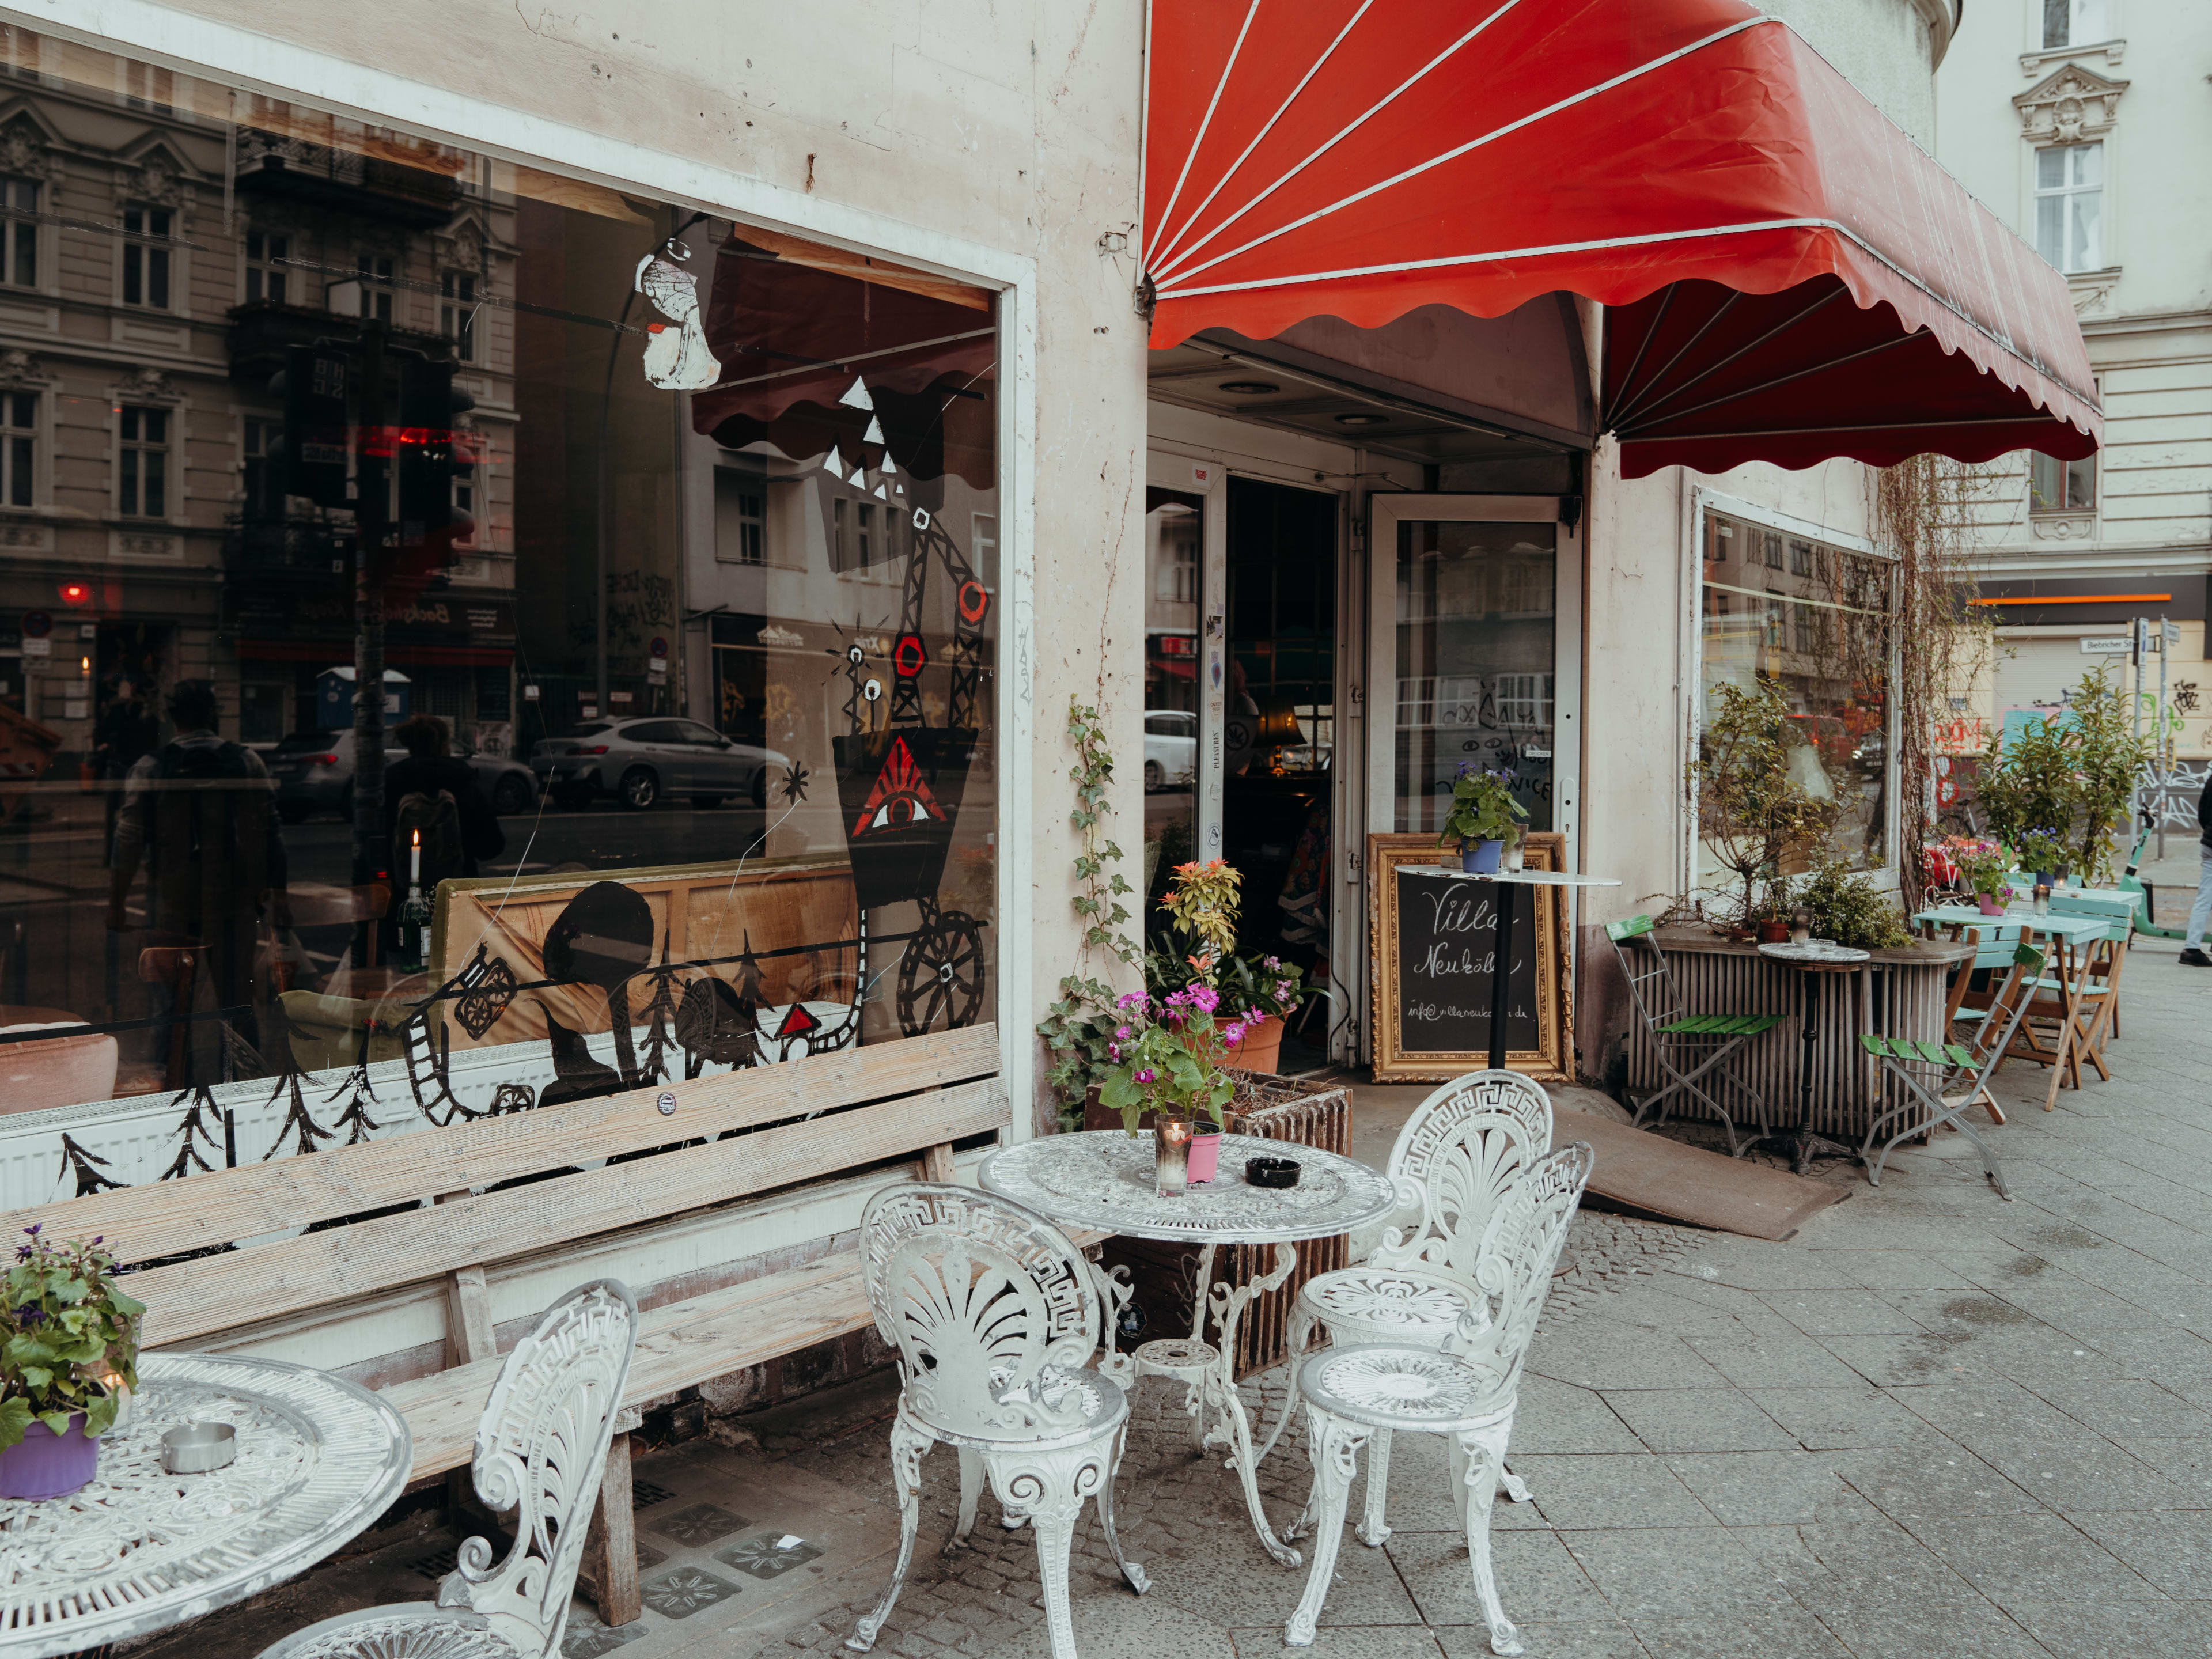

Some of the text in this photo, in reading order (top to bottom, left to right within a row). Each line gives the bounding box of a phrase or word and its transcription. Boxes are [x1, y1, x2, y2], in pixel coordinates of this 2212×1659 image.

[2087, 640, 2122, 649] Biebricher
[1422, 883, 1519, 935] Villa
[1414, 941, 1521, 978] Neuköll
